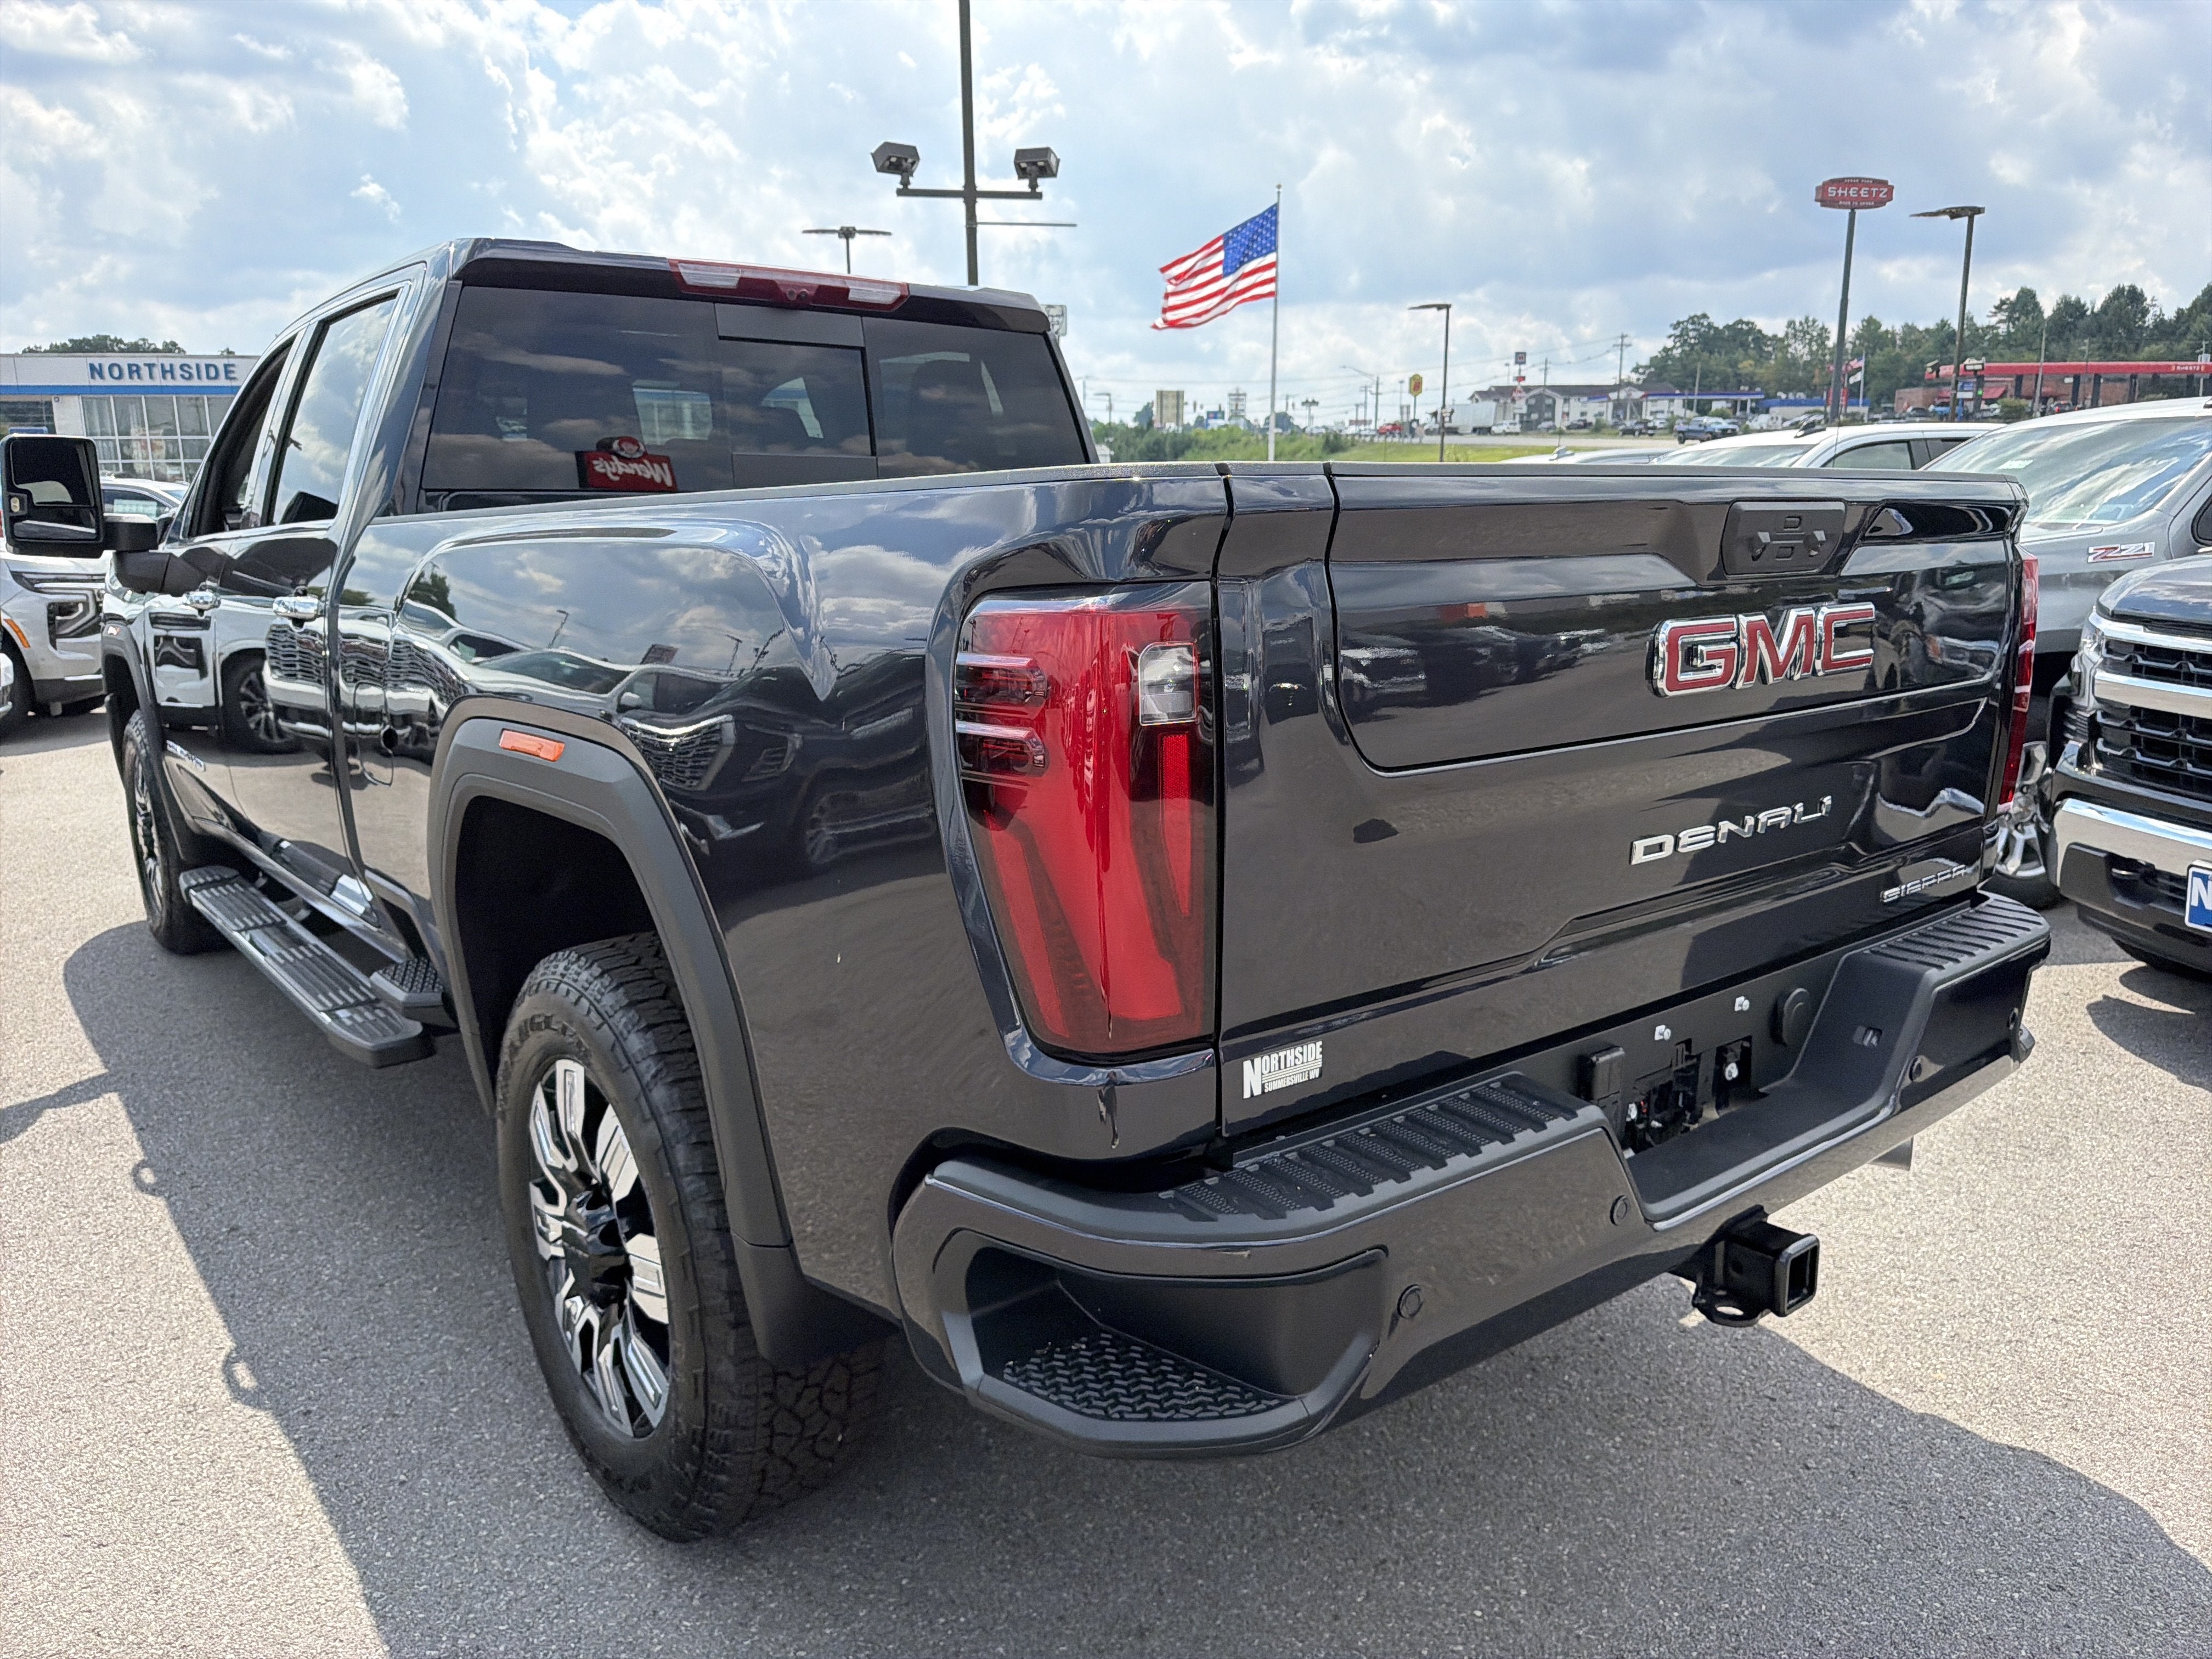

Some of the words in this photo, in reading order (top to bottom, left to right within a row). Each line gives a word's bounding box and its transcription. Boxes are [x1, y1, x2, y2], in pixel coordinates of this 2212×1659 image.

[1827, 187, 1888, 198] SHEETZ
[88, 362, 238, 381] NORTHSIDE
[2087, 541, 2155, 563] Z71
[1649, 601, 1876, 697] GMC
[1629, 795, 1832, 865] DENALI
[1881, 864, 1967, 903] SIERRA
[1243, 1040, 1323, 1099] NORTHSIDE
[1264, 1071, 1308, 1093] SUMMERSVILLE
[1309, 1068, 1320, 1080] WV
